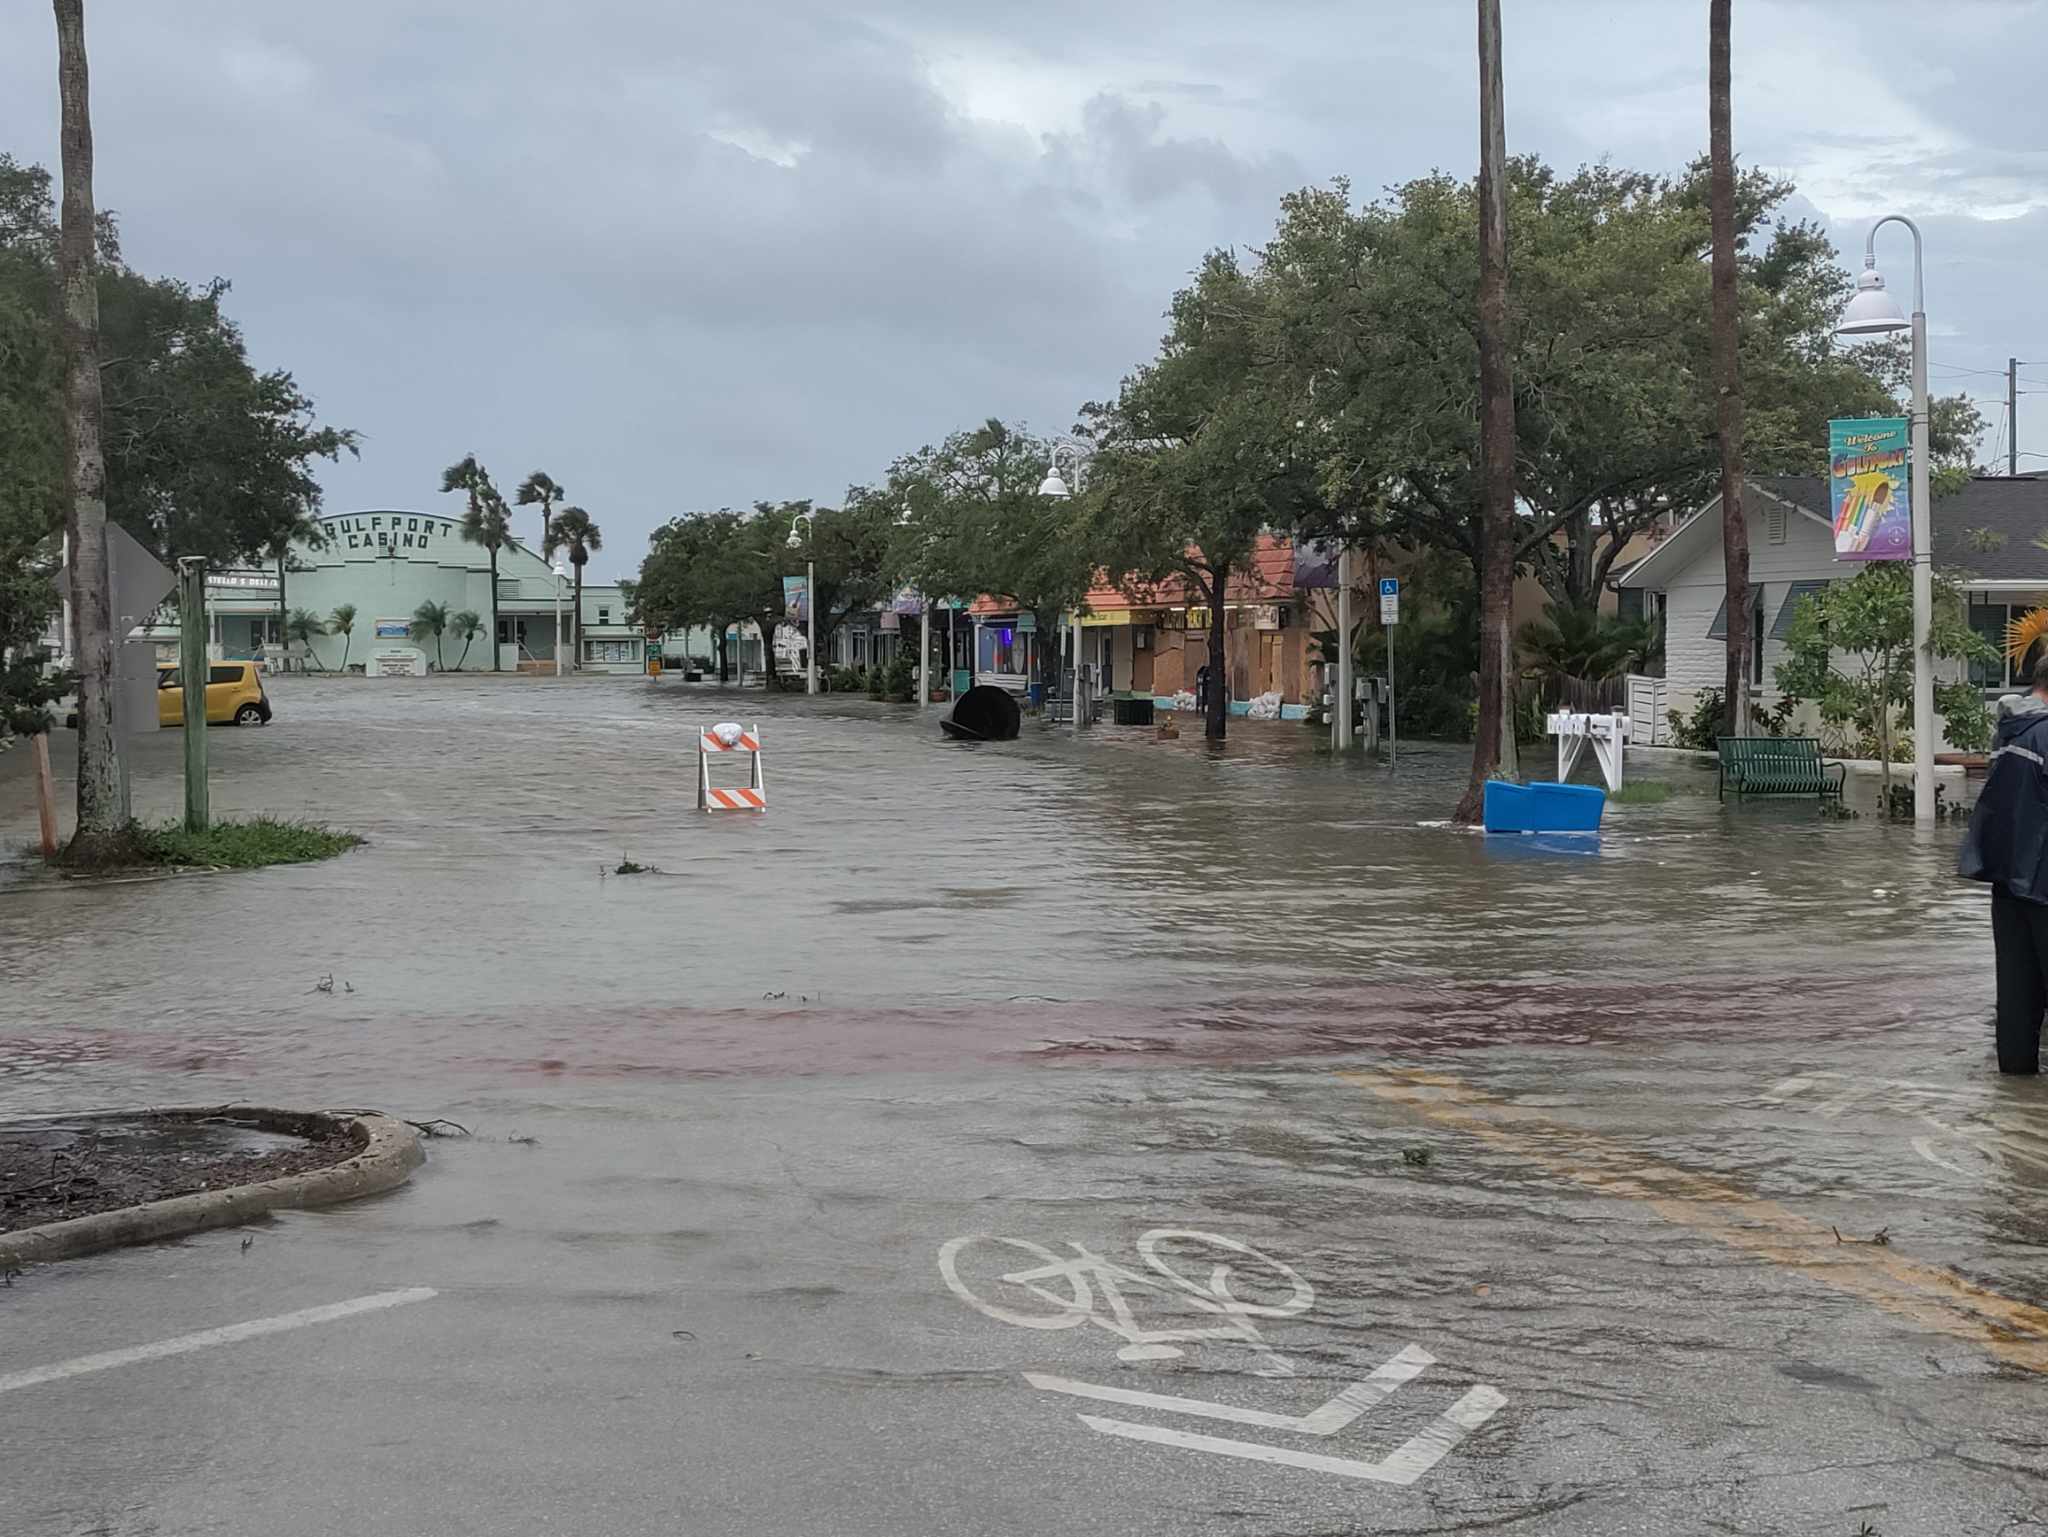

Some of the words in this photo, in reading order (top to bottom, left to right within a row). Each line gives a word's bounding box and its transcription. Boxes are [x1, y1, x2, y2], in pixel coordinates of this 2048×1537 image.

[1844, 431, 1897, 446] Welcome
[323, 516, 452, 537] GULFPORT
[347, 531, 428, 549] CASINO
